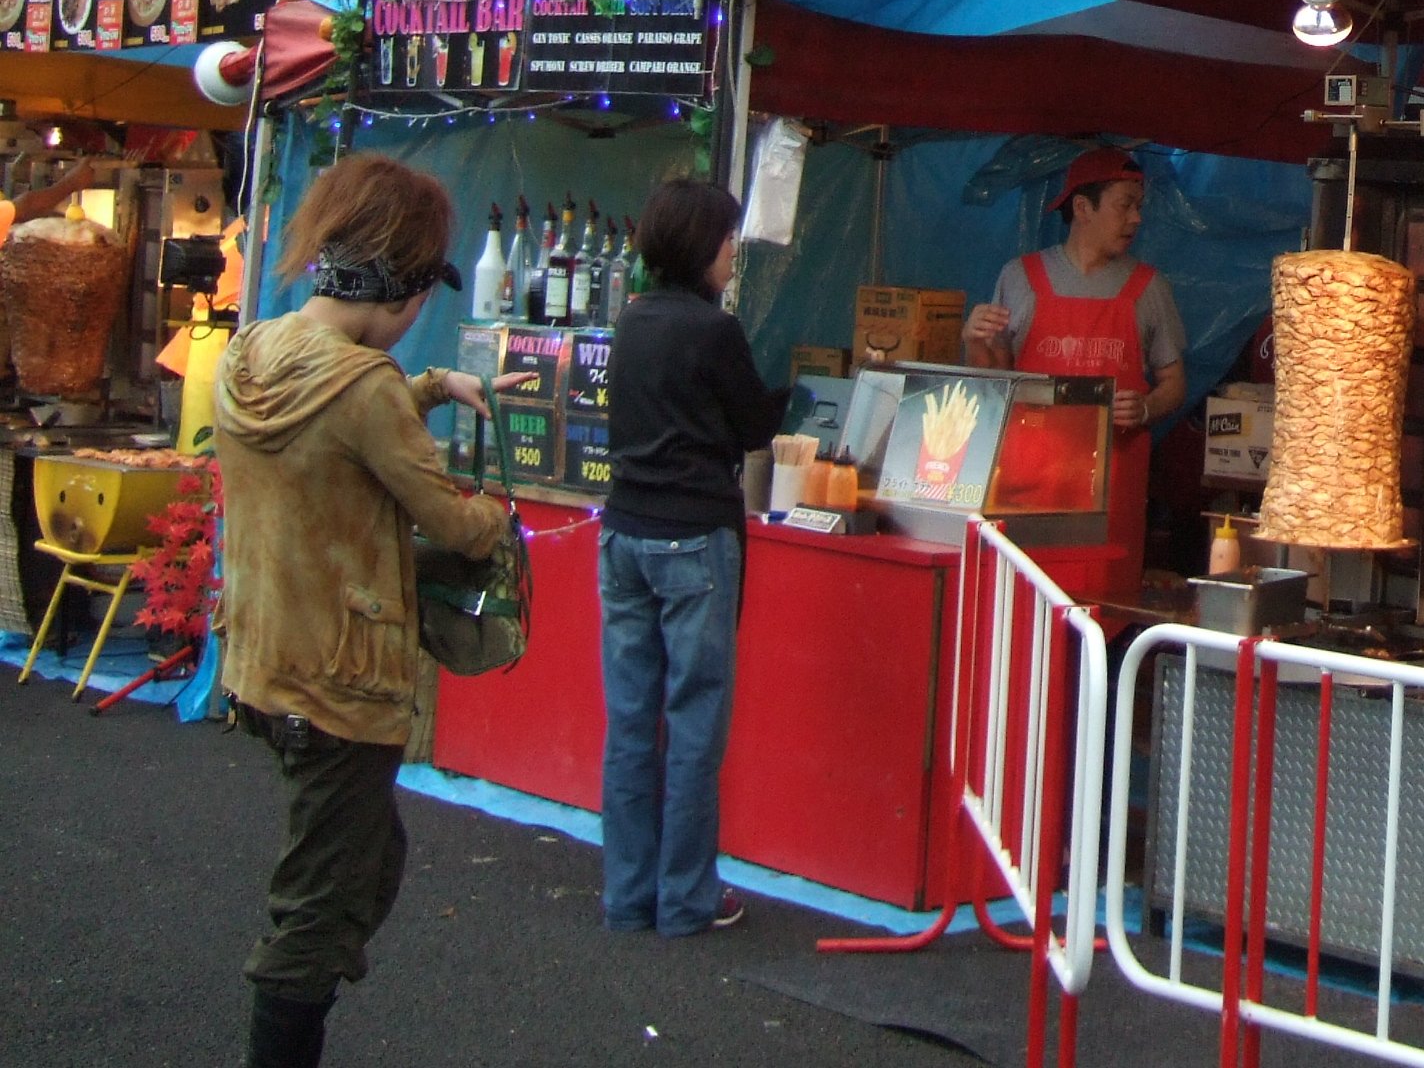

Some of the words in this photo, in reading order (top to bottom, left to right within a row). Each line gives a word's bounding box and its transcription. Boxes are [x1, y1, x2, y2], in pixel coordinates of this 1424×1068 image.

[533, 32, 548, 44] GIN
[602, 32, 634, 44] ORANGE
[637, 32, 673, 45] PARAISO
[674, 32, 702, 45] GRAPE
[629, 60, 666, 73] CAMPARI
[667, 61, 702, 74] ORANGE
[508, 335, 562, 356] COCKTAIL
[589, 369, 609, 384] ワイ
[509, 414, 547, 436] BEER
[514, 447, 541, 467] ¥500
[947, 483, 983, 503] ¥300
